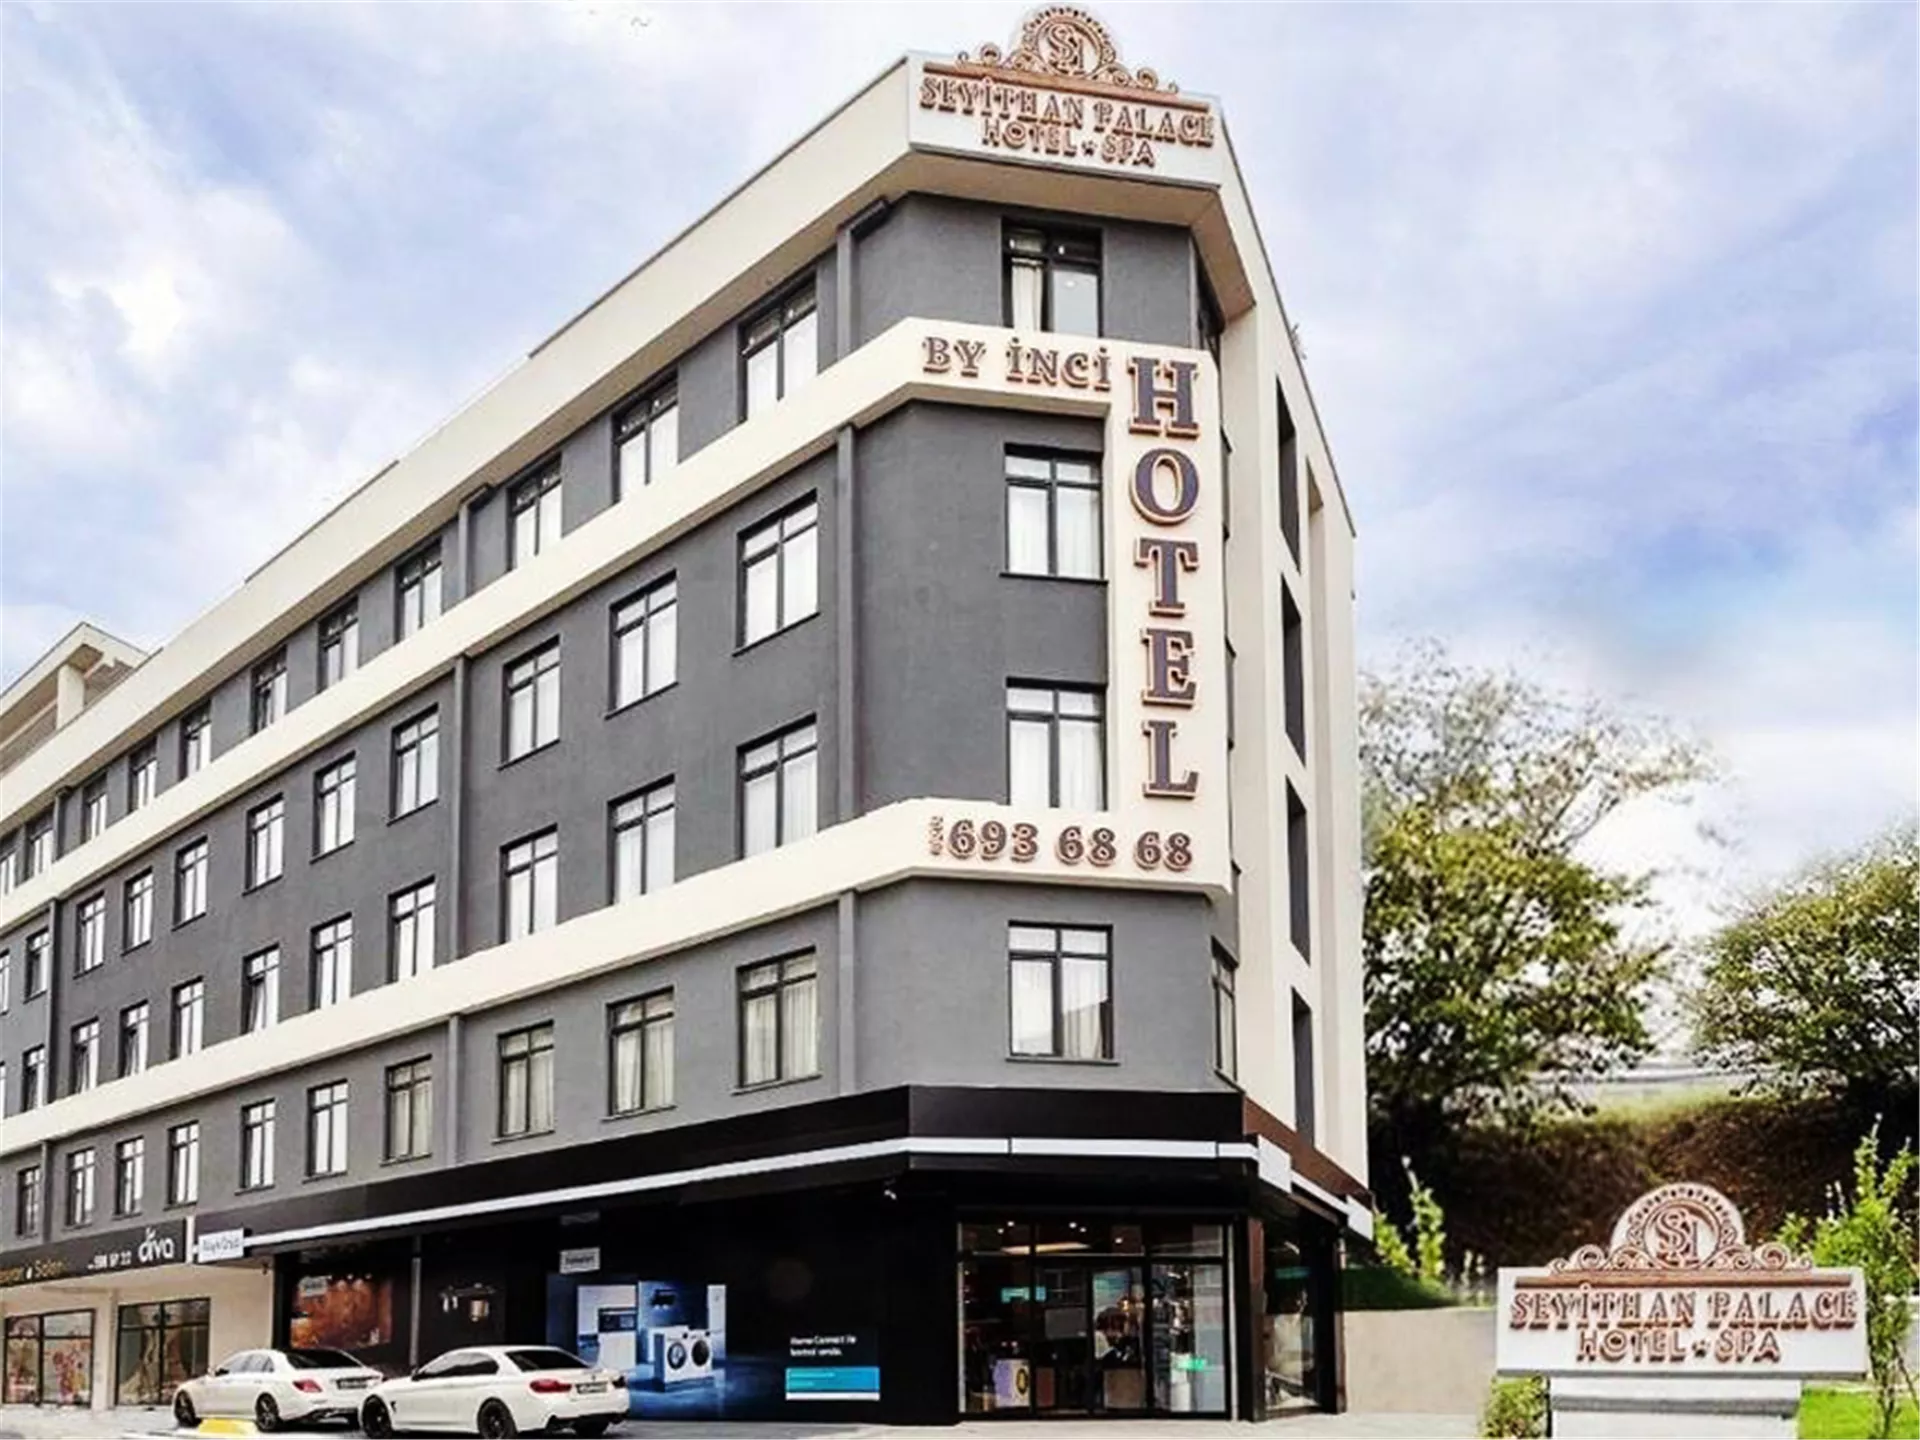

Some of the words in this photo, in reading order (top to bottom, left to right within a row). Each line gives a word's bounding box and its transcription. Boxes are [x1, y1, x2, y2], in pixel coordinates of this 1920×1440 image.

[981, 119, 1078, 158] HOTEL
[1101, 135, 1156, 169] SPA
[1092, 102, 1216, 149] PALACE
[922, 336, 987, 378] BY
[1126, 355, 1200, 802] HOTEL
[949, 818, 1039, 864] 693
[1056, 825, 1117, 868] 68
[1135, 830, 1193, 873] 68
[1706, 1290, 1858, 1330] PALACE
[1576, 1330, 1687, 1363] HOTEL
[1714, 1330, 1782, 1364] SPA
